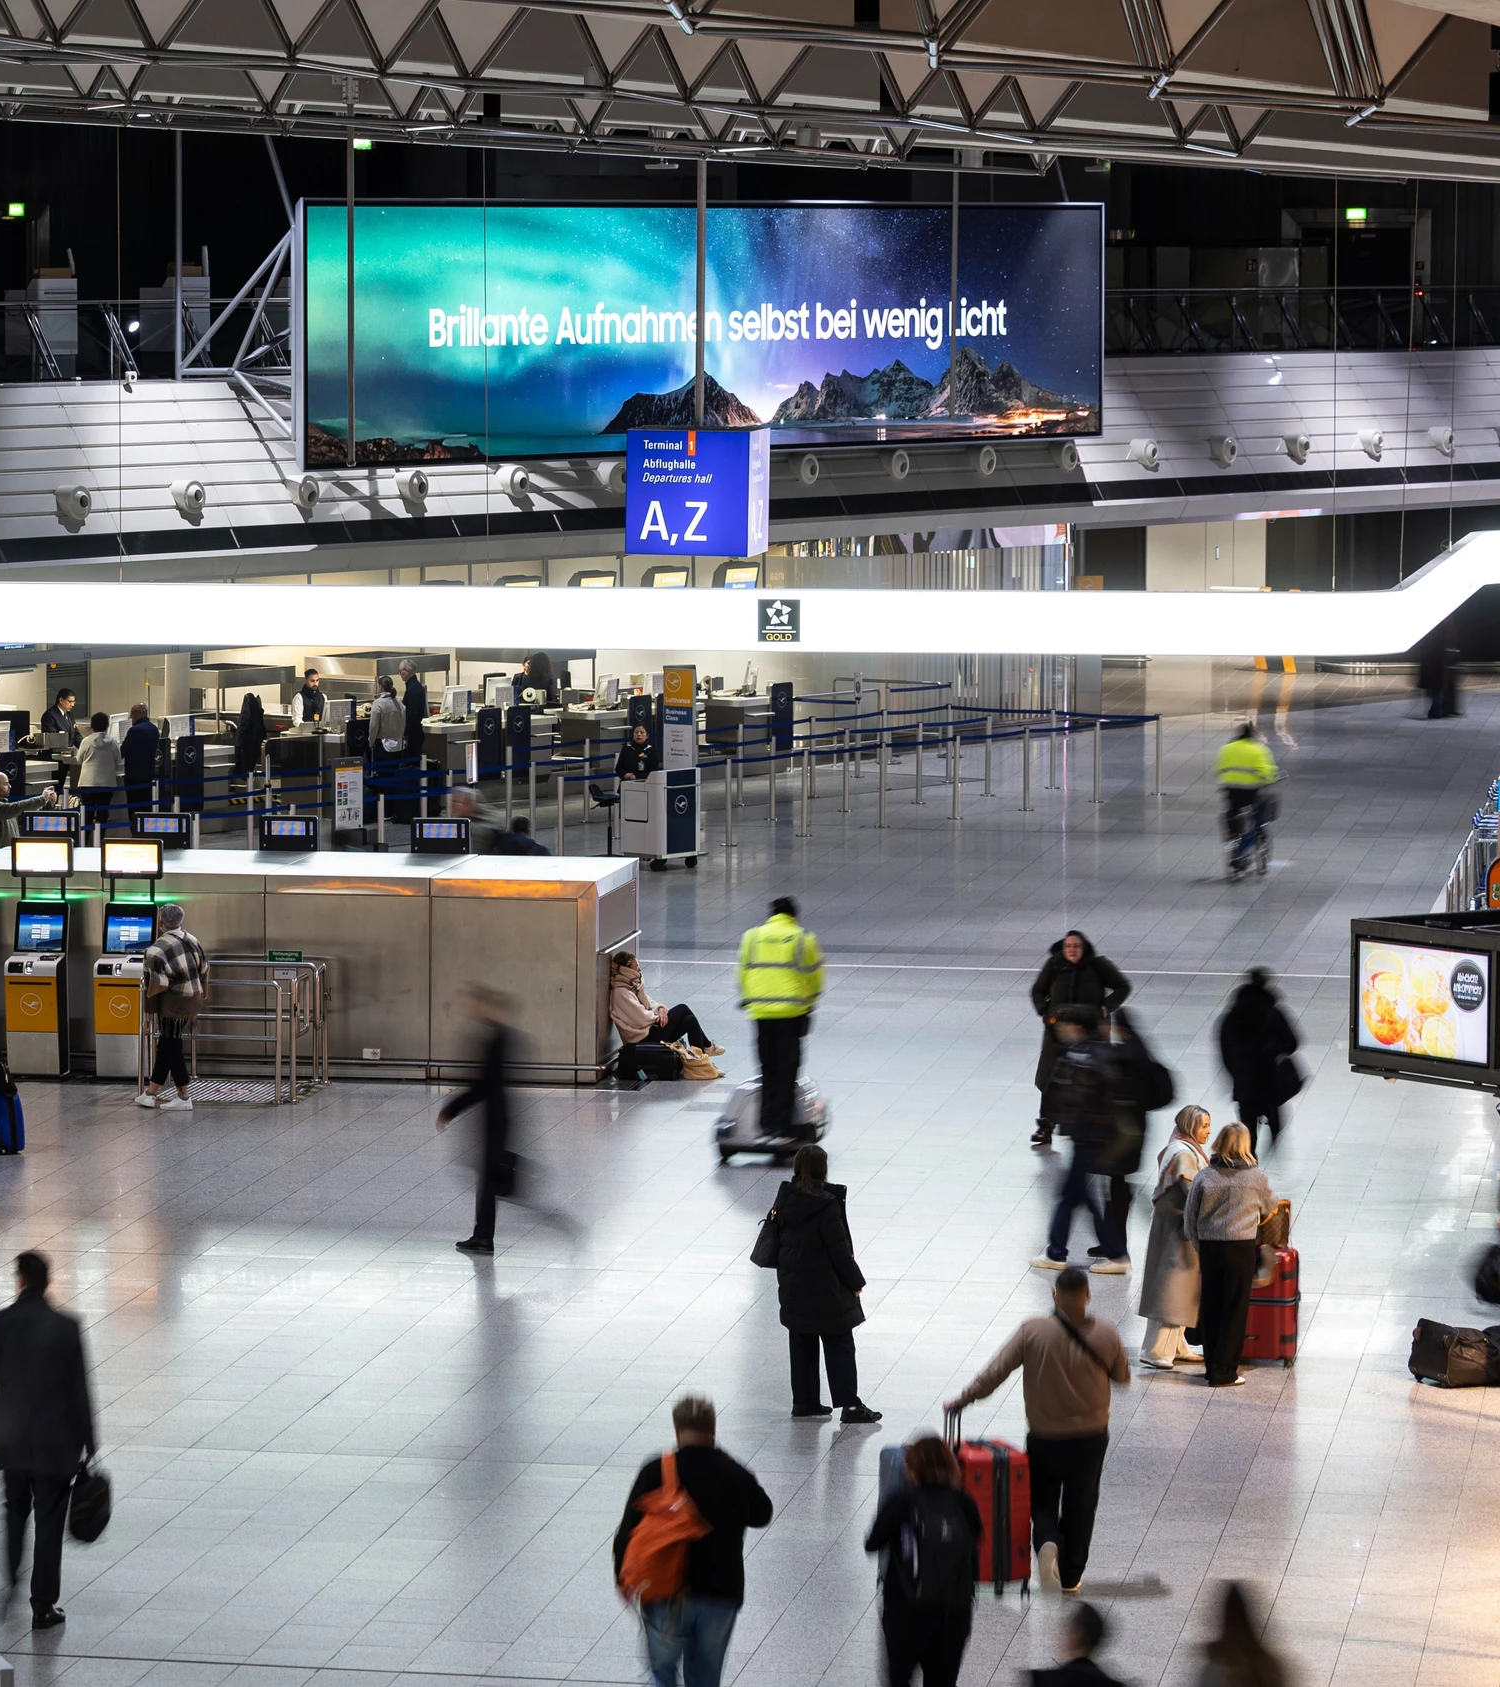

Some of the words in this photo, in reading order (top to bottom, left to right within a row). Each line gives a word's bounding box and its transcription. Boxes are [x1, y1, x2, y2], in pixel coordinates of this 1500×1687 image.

[428, 304, 549, 348] Brillante
[555, 302, 722, 346] Aufnahmen
[727, 301, 810, 342] selbst
[816, 298, 857, 340] bei
[863, 297, 943, 350] wenig
[644, 439, 682, 450] Terminal
[689, 441, 693, 450] 1
[643, 459, 696, 470] Abflughalle
[642, 472, 692, 484] Departures
[694, 474, 712, 483] hall
[640, 500, 708, 546] A,Z
